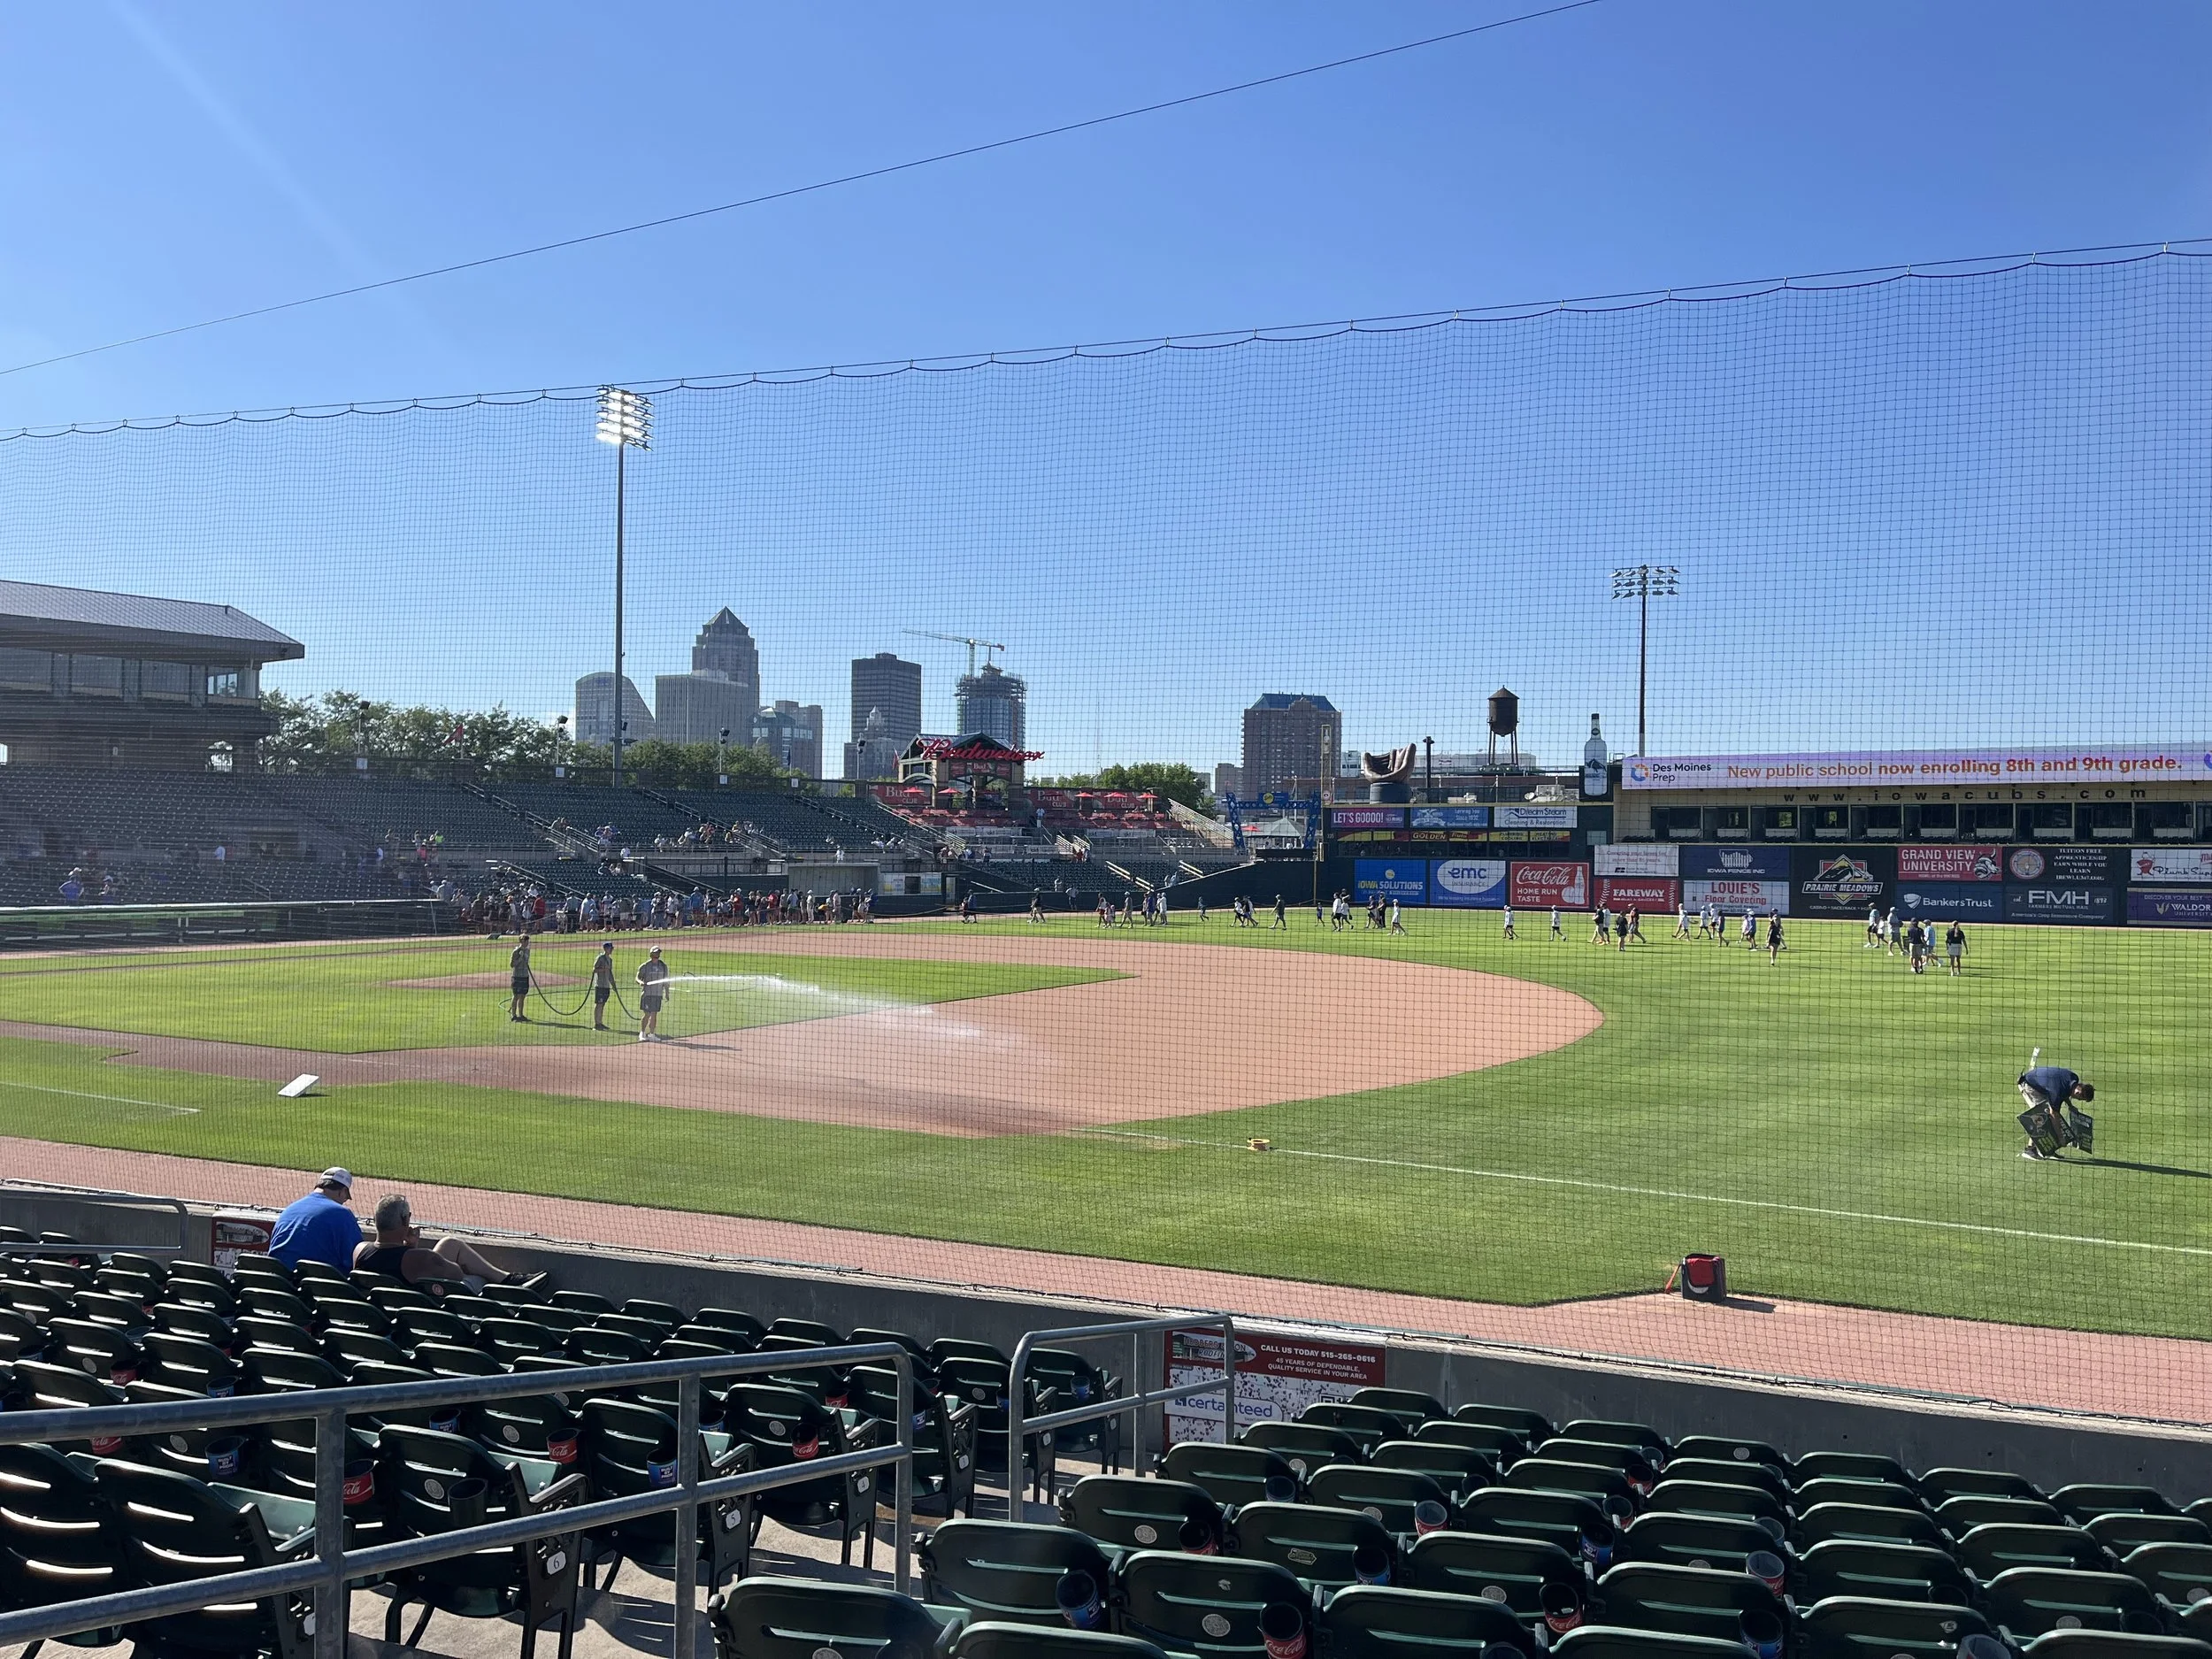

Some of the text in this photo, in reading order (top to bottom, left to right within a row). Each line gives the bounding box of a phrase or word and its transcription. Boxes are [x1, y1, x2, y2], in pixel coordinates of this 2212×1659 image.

[917, 738, 1045, 761] Budweiser
[1653, 763, 1711, 772] Des Moines
[1728, 755, 2182, 780] New public school now enrolling 8th and 9th grade.
[1653, 772, 1675, 783] Prep
[1333, 812, 1354, 823] LET'S
[1901, 849, 1975, 860] GRAND VIEW
[1903, 861, 1972, 872] UNIVERSITY
[2153, 866, 2188, 875] Plumb
[1448, 867, 1486, 879] emc
[1516, 865, 1572, 886] Coca-Cola
[1358, 880, 1423, 890] IOWA SOLUTIONS
[1711, 881, 1760, 894] LOUIE'S
[1729, 895, 1766, 905] Covering
[2028, 890, 2089, 904] FMH
[1198, 1348, 1225, 1359] ROOFIN
[1294, 1348, 1319, 1357] TODAY
[1321, 1351, 1376, 1363] 515-265-0616
[1295, 1366, 1322, 1375] SERVICE
[1317, 1363, 1361, 1372] DEPENDABLE,
[1188, 1398, 1272, 1417] certateed
[730, 1515, 736, 1525] 5
[554, 1557, 560, 1570] 6
[1265, 1637, 1302, 1656] Coca-Cola
